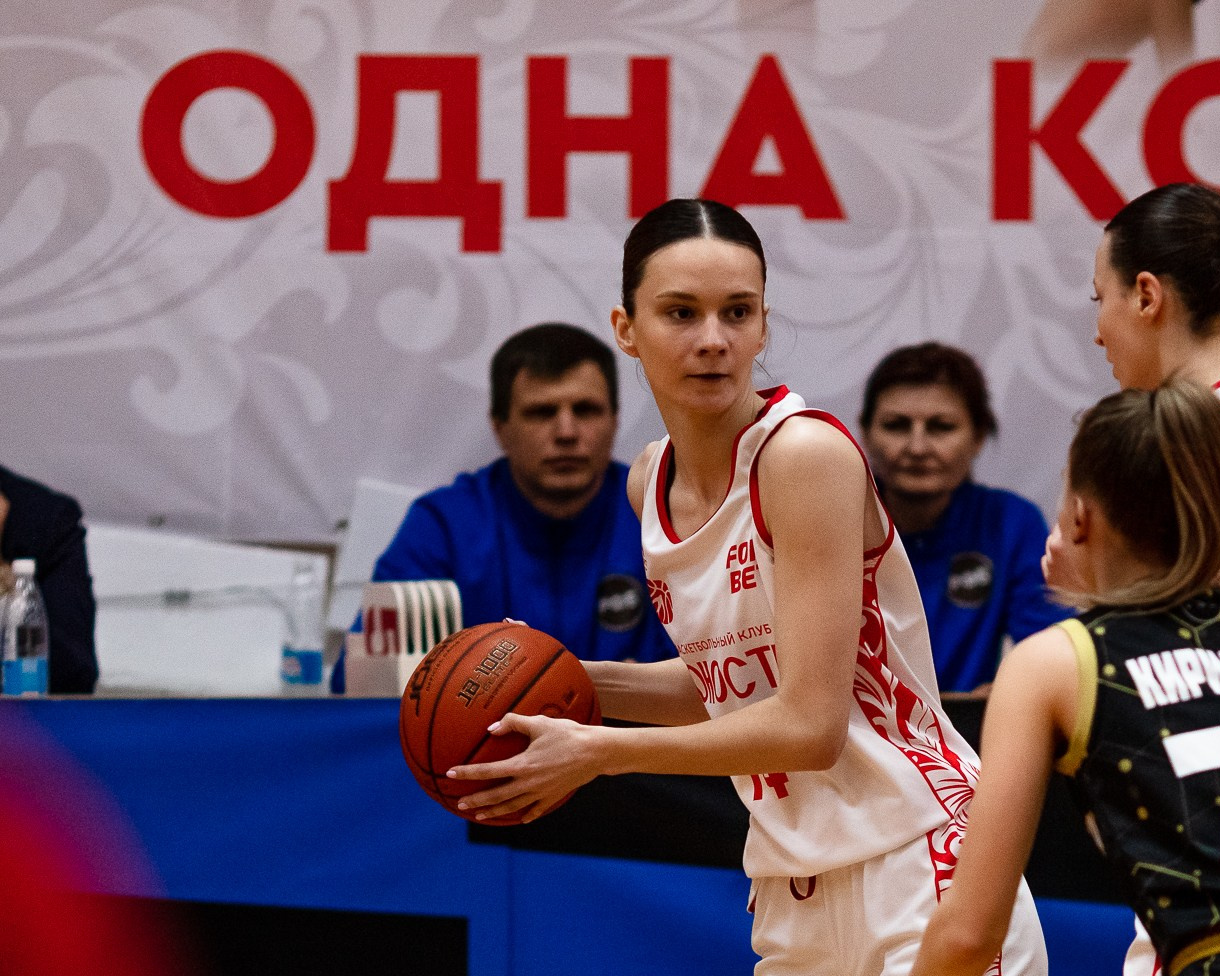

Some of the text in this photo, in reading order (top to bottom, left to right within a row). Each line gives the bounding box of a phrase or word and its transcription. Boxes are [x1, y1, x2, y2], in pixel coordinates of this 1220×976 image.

[139, 48, 848, 253] ОДНА
[730, 563, 759, 594] BE
[737, 623, 772, 642] КЛУБ
[457, 639, 518, 708] JB-1000
